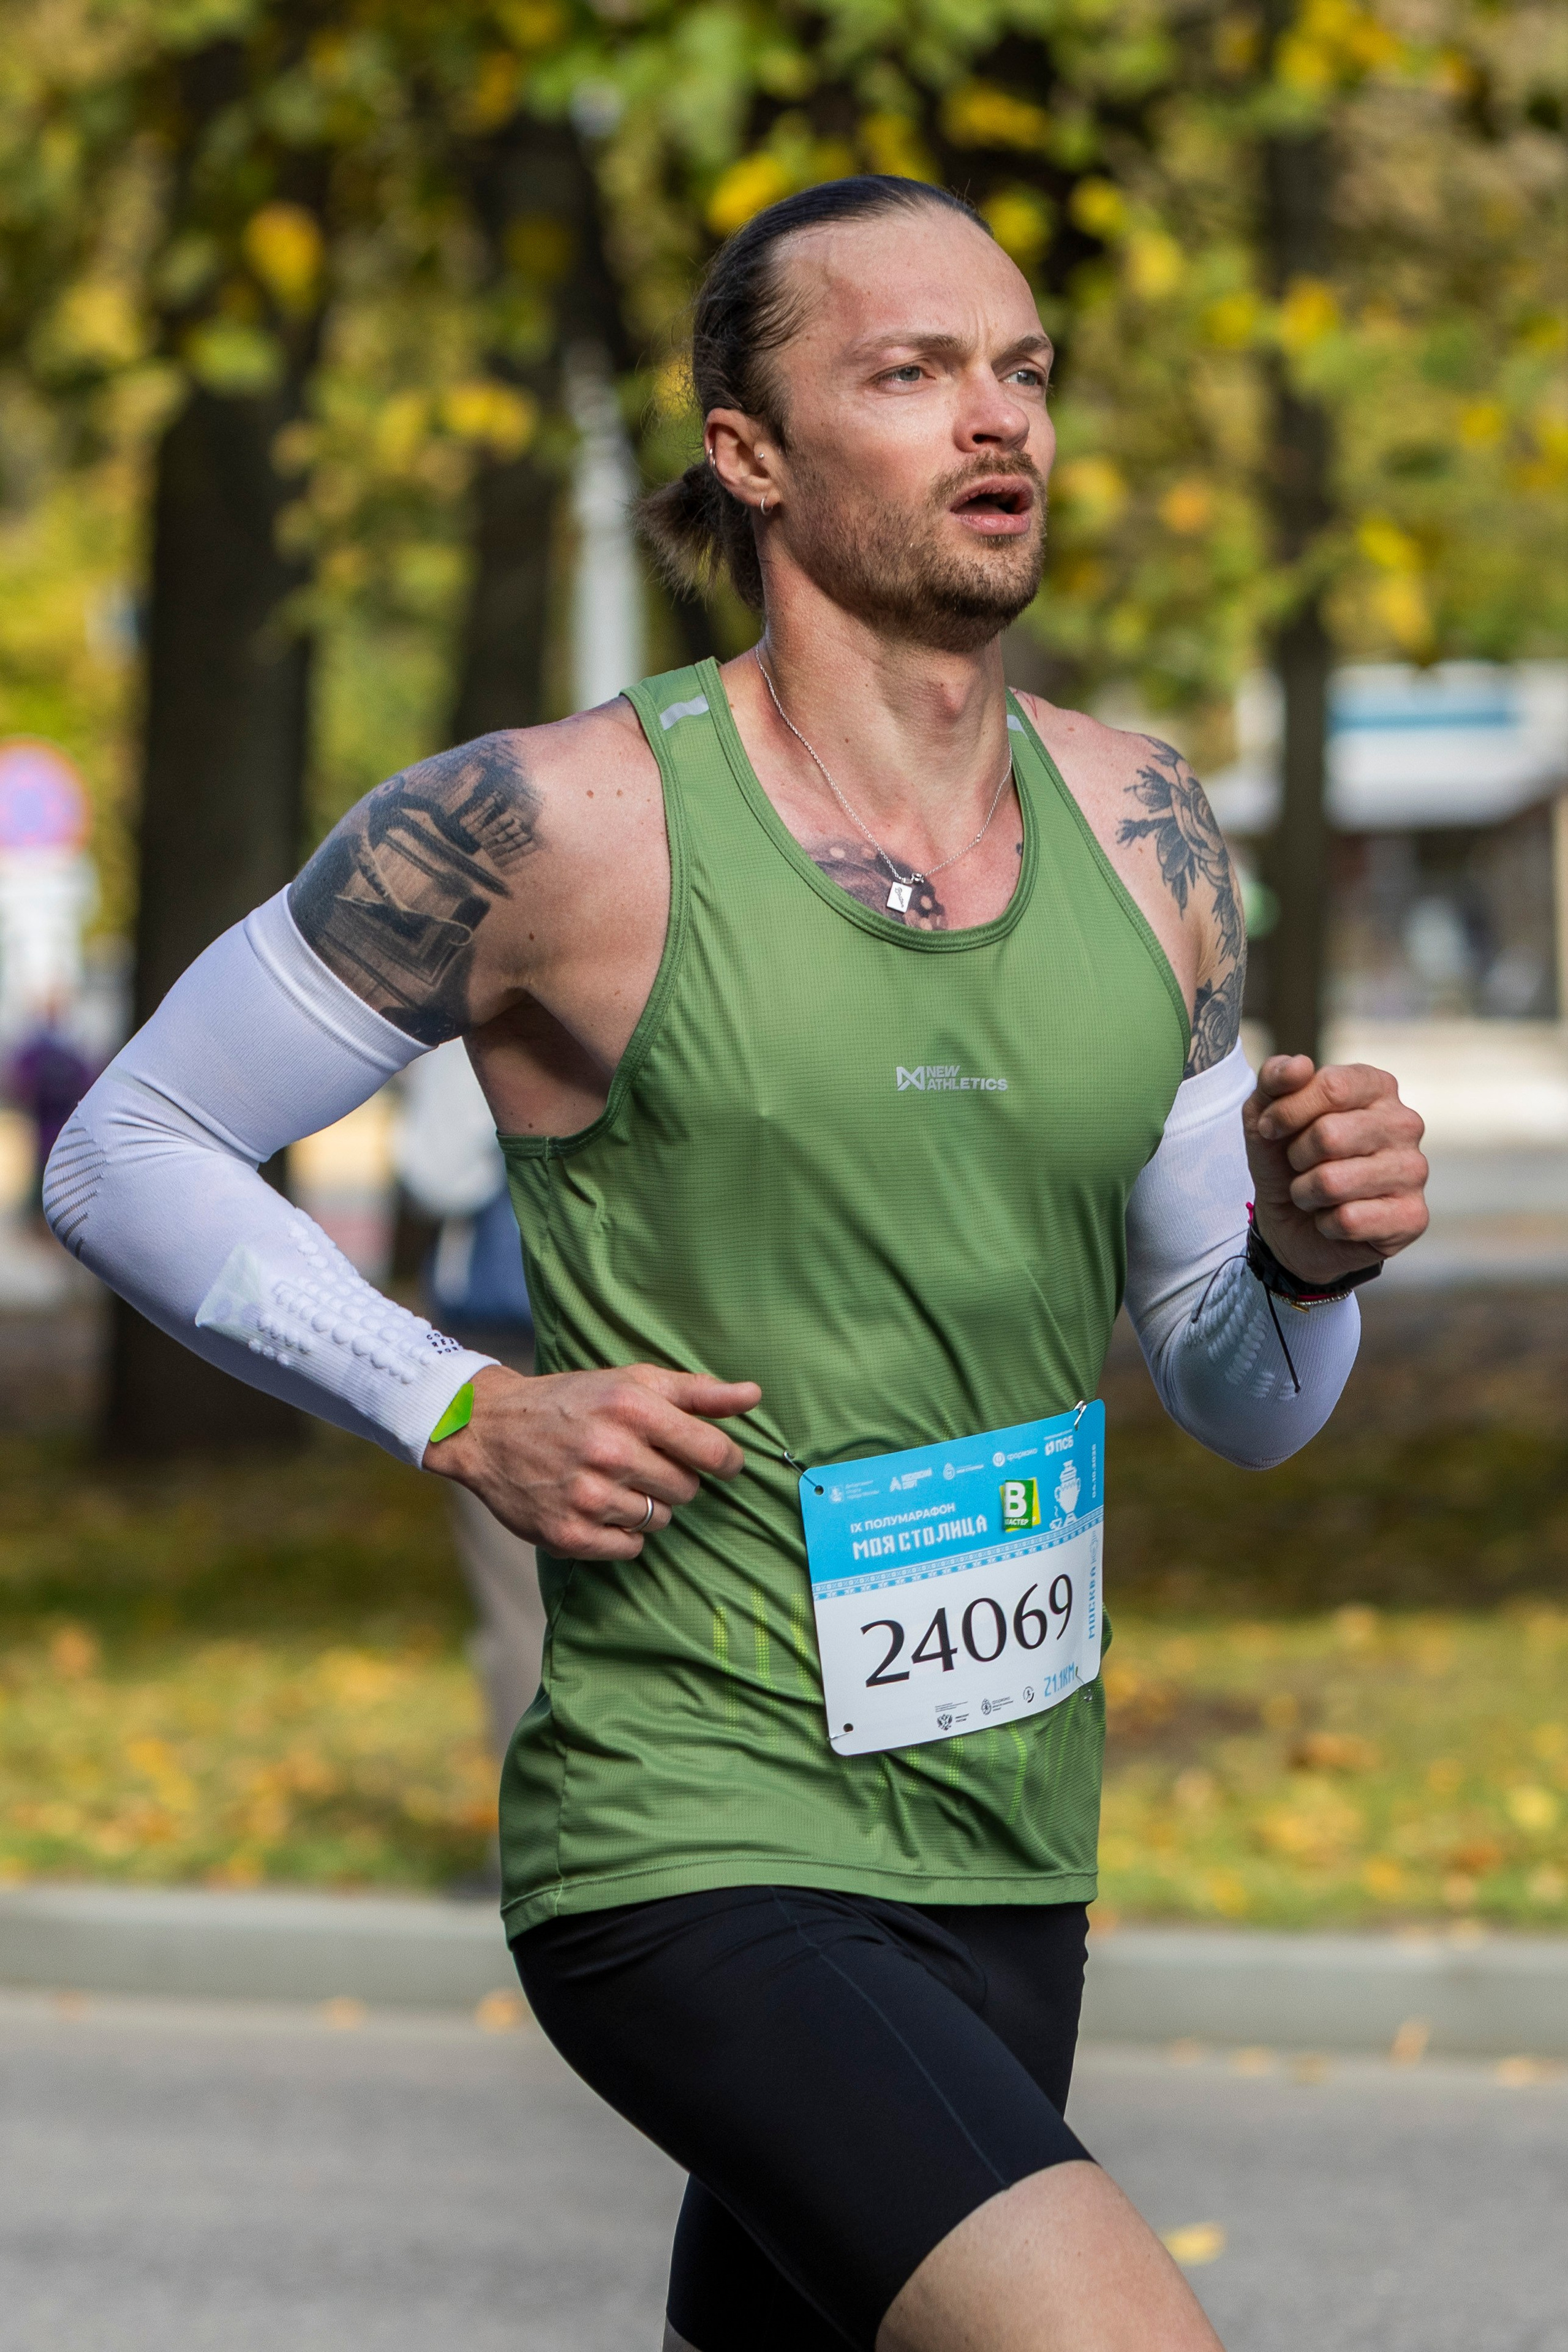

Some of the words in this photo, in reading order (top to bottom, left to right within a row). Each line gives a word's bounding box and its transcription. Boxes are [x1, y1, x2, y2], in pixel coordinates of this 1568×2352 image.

[926, 1065, 960, 1078] NEW
[927, 1078, 1008, 1091] ATHLETICS
[1055, 1435, 1074, 1453] ПСБ
[850, 1523, 863, 1533] IX
[864, 1502, 956, 1530] ПОЛУМАРАФОН
[853, 1535, 895, 1560] МОЯ
[898, 1514, 988, 1551] СТОЛИЦА
[860, 1573, 1073, 1688] 24069
